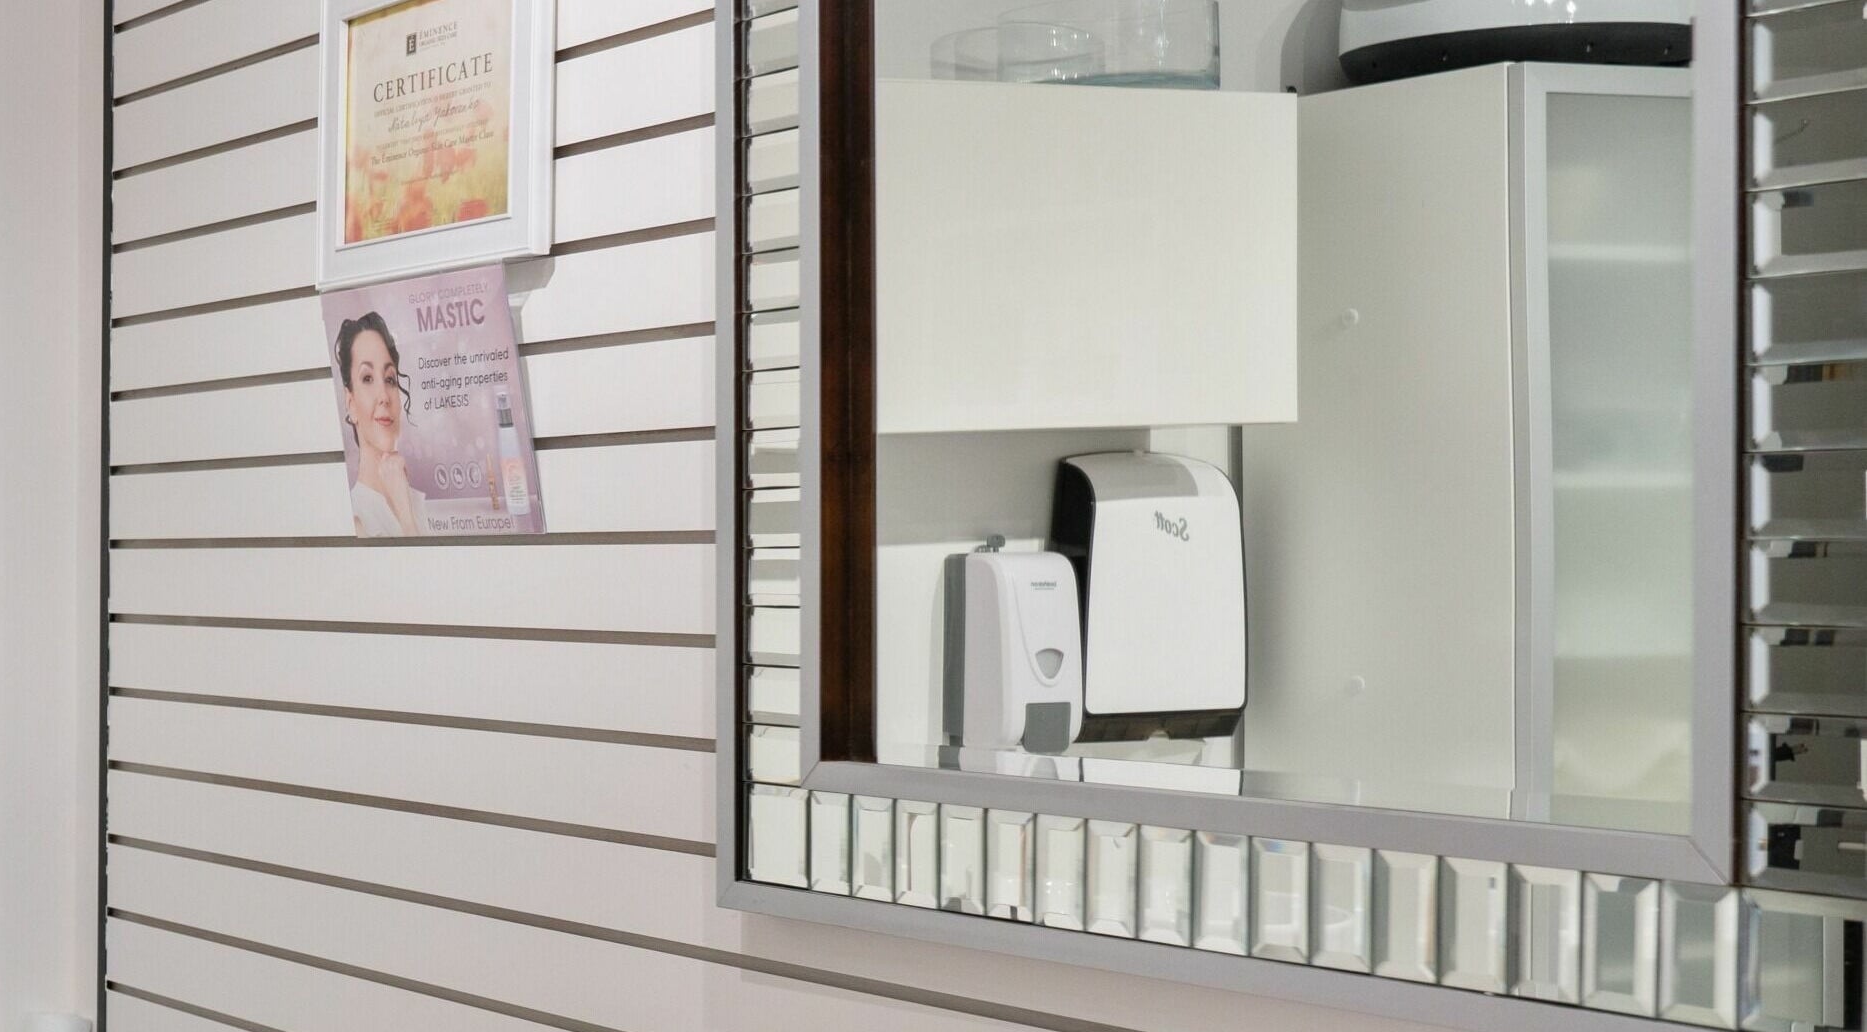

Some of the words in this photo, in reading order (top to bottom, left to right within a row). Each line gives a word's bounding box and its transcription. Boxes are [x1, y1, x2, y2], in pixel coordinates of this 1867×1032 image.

[373, 52, 493, 103] CERTIFICATE
[416, 298, 485, 332] MASTIC
[418, 356, 451, 369] Discover
[454, 352, 467, 365] the
[470, 346, 509, 363] unrivaled
[421, 375, 462, 390] anti-aging
[465, 370, 508, 388] properties
[424, 397, 432, 410] of
[435, 393, 469, 410] LAKESIS
[427, 516, 448, 530] New
[450, 515, 474, 530] From
